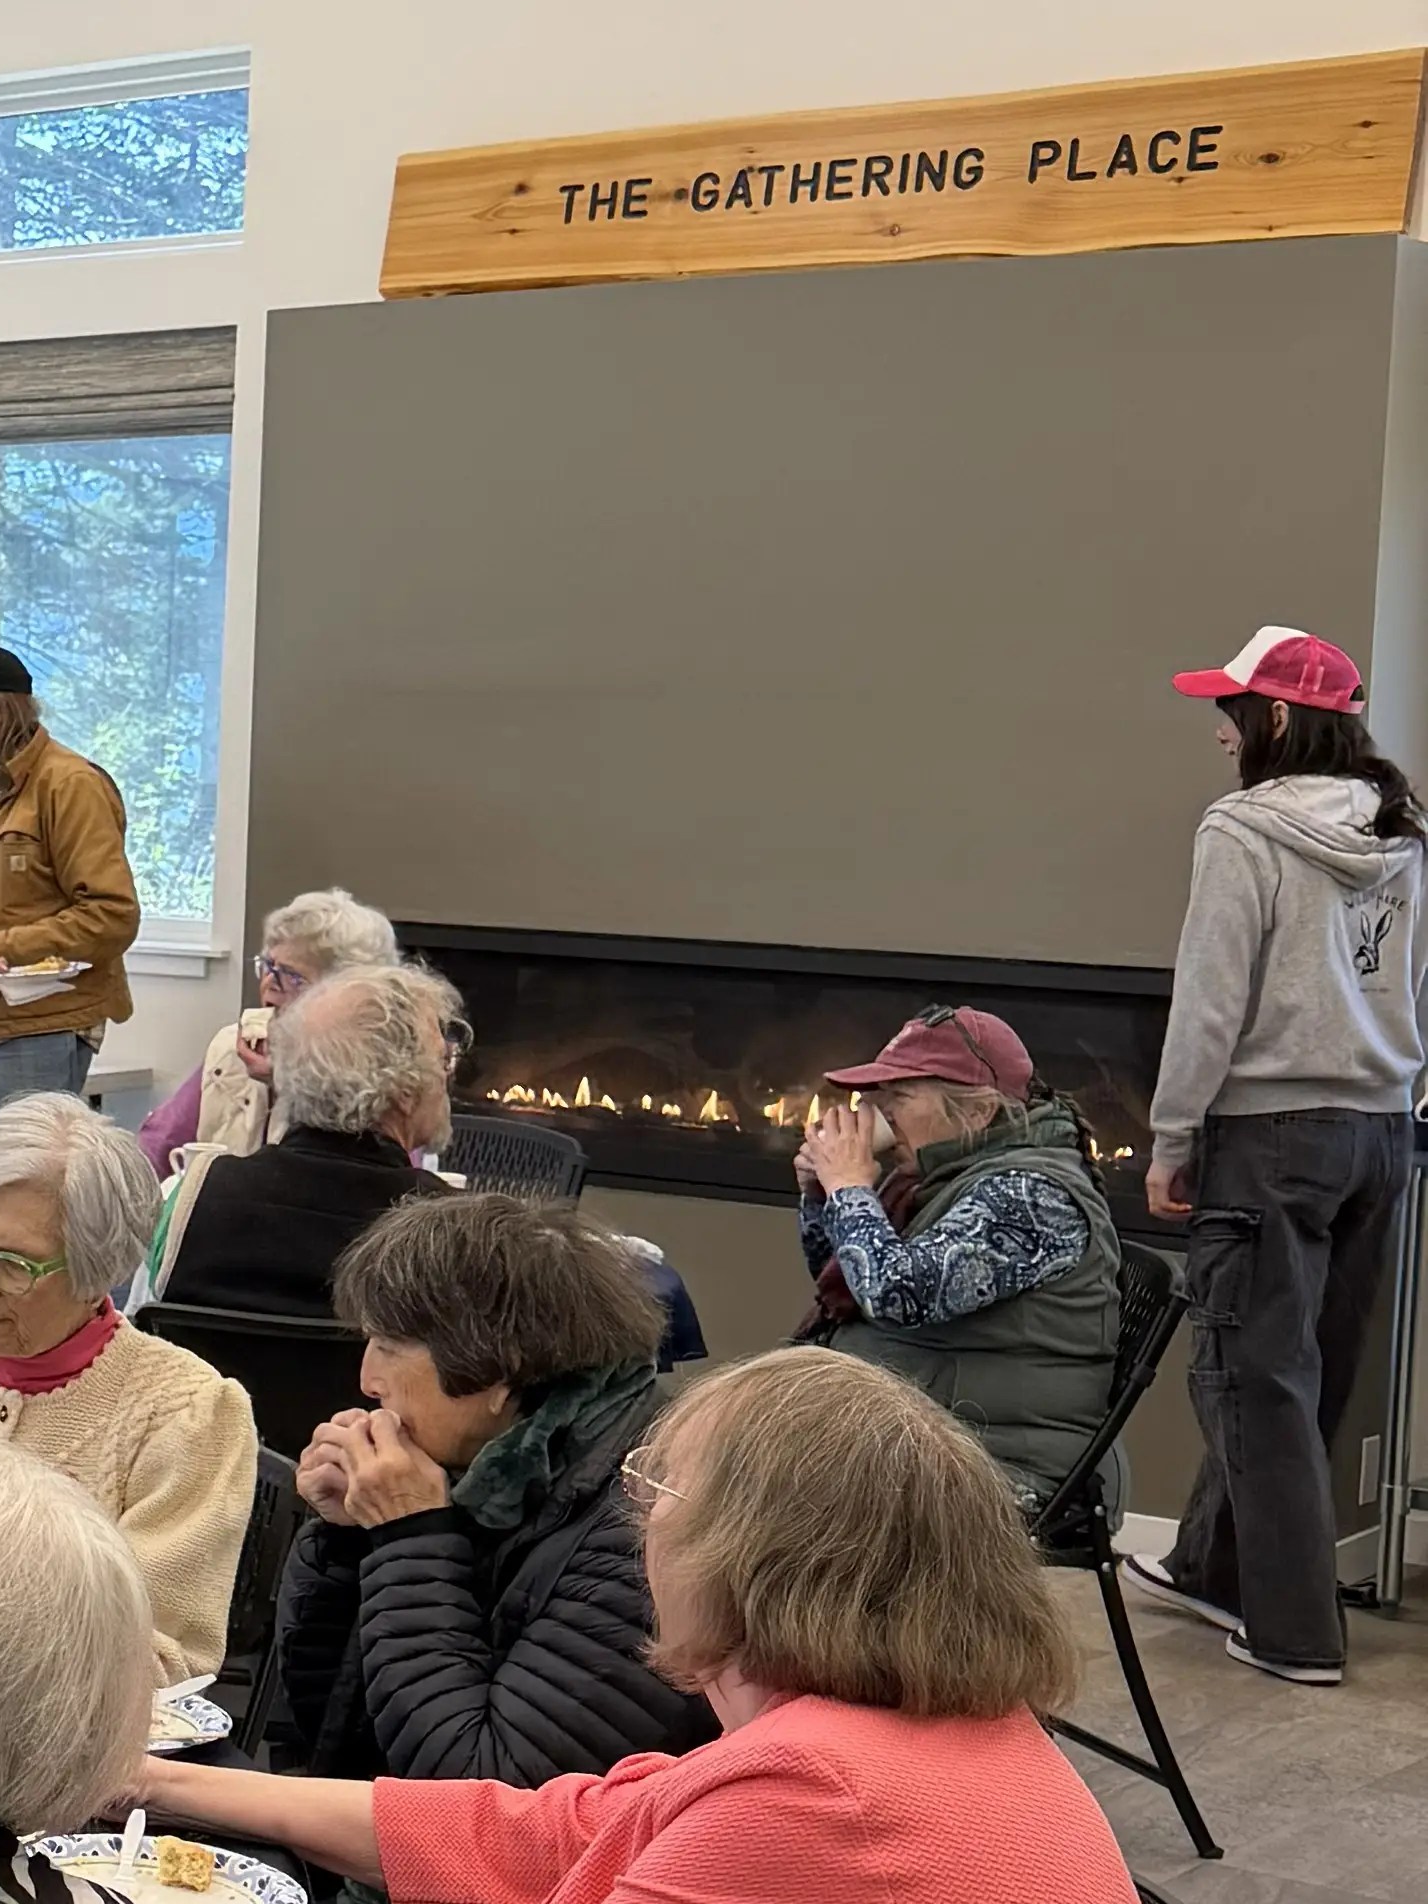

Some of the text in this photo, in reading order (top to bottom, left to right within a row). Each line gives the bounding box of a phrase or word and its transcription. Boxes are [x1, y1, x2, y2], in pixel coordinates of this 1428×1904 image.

[559, 124, 1225, 225] THE GATHERING PLACE
